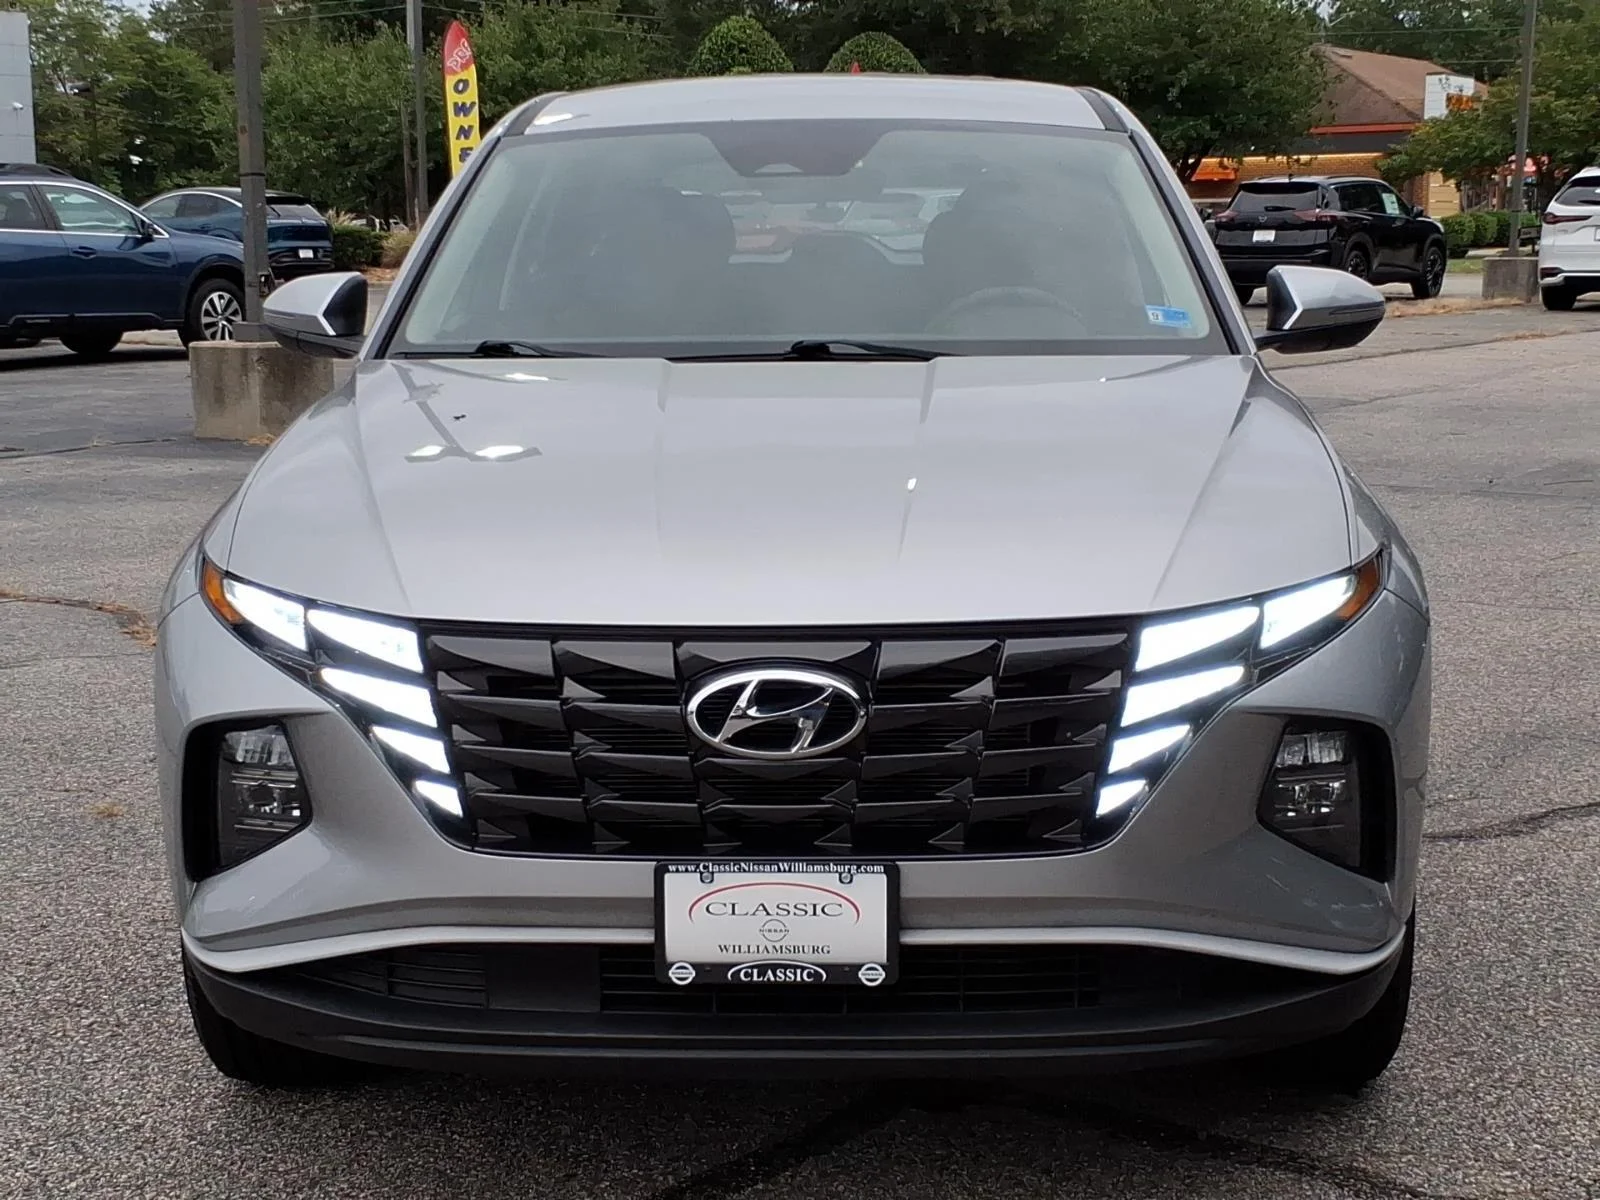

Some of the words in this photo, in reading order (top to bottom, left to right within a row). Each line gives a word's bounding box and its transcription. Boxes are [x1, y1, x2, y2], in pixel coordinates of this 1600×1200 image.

[668, 862, 885, 874] www.ClassicNissanWilliamsburg.com
[705, 902, 844, 917] CLASSIC
[718, 944, 832, 955] WILLIAMSBURG
[739, 968, 815, 982] CLASSIC
